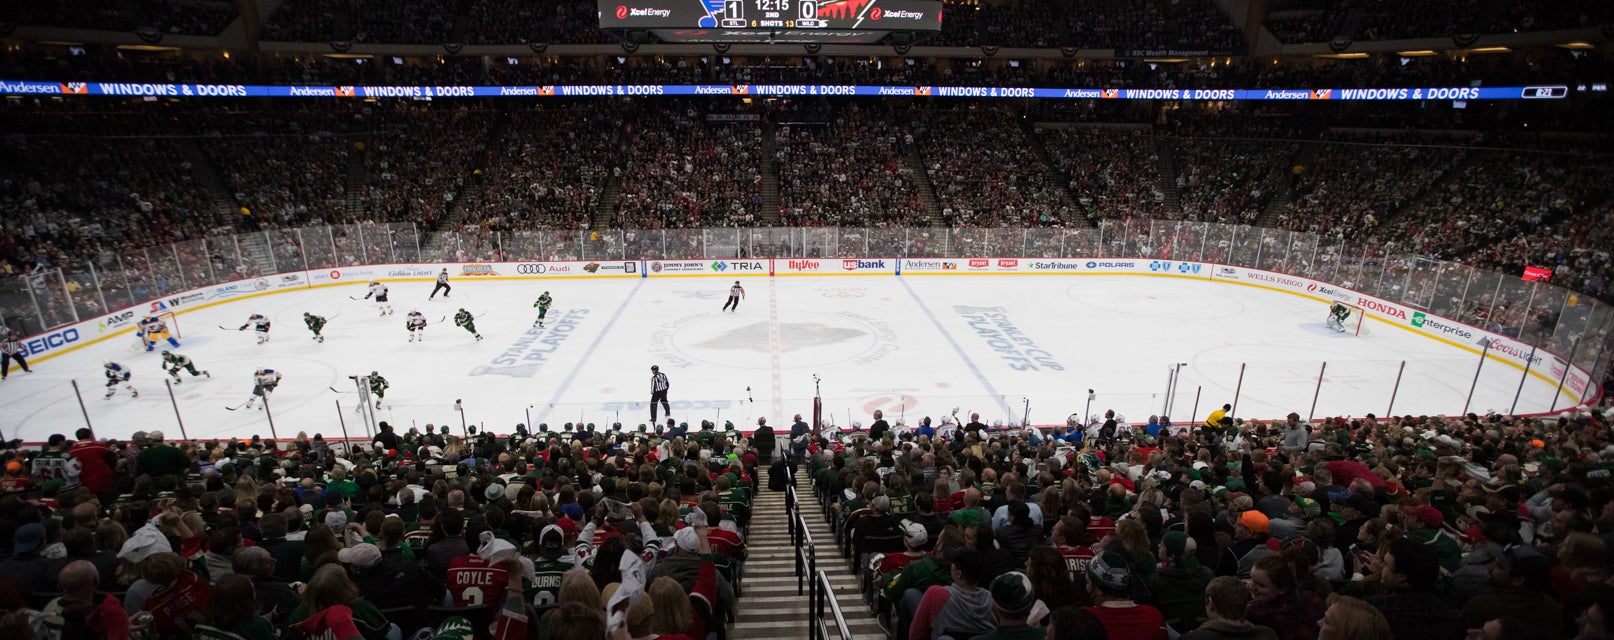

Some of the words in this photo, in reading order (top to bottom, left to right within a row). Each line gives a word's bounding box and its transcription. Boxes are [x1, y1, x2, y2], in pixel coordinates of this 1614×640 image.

[729, 2, 737, 18] 1
[756, 0, 789, 10] 12:15
[802, 1, 813, 18] 0
[0, 81, 60, 93] Andersen
[99, 82, 177, 95] WINDOWS
[182, 84, 194, 95] &
[196, 84, 247, 96] DOORS
[290, 86, 334, 96] Andersen
[363, 86, 421, 96] WINDOWS
[425, 87, 433, 96] &
[436, 87, 474, 96] DOORS
[501, 87, 537, 95] Andersen
[562, 86, 613, 95] WINDOWS
[617, 86, 624, 95] &
[628, 85, 663, 95] DOORS
[695, 86, 731, 94] Andersen
[756, 85, 806, 94] WINDOWS
[810, 85, 817, 94] &
[821, 86, 856, 95] DOORS
[879, 87, 914, 95] Andersen
[939, 87, 987, 96] WINDOWS
[991, 88, 997, 97] &
[1001, 88, 1035, 97] DOORS
[1064, 89, 1100, 98] Andersen
[1126, 90, 1179, 99] WINDOWS
[1183, 90, 1190, 99] &
[1195, 89, 1235, 99] DOORS
[1265, 90, 1308, 99] Andersen
[1341, 88, 1408, 100] WINDOWS
[1413, 88, 1422, 99] &
[1427, 87, 1479, 99] DOORS
[730, 262, 763, 270] TRIA
[1247, 272, 1276, 283] WELLS
[1276, 276, 1303, 288] FARGO
[1319, 286, 1334, 295] Xcel
[1357, 297, 1407, 320] HONDA
[107, 311, 134, 326] AMP
[1415, 315, 1472, 339] enterprise
[523, 308, 590, 361] PLAYOFFS
[961, 315, 1040, 371] PLAYOFFS
[1489, 338, 1519, 356] Coors
[1025, 348, 1065, 371] CUP
[456, 571, 494, 585] COYLE
